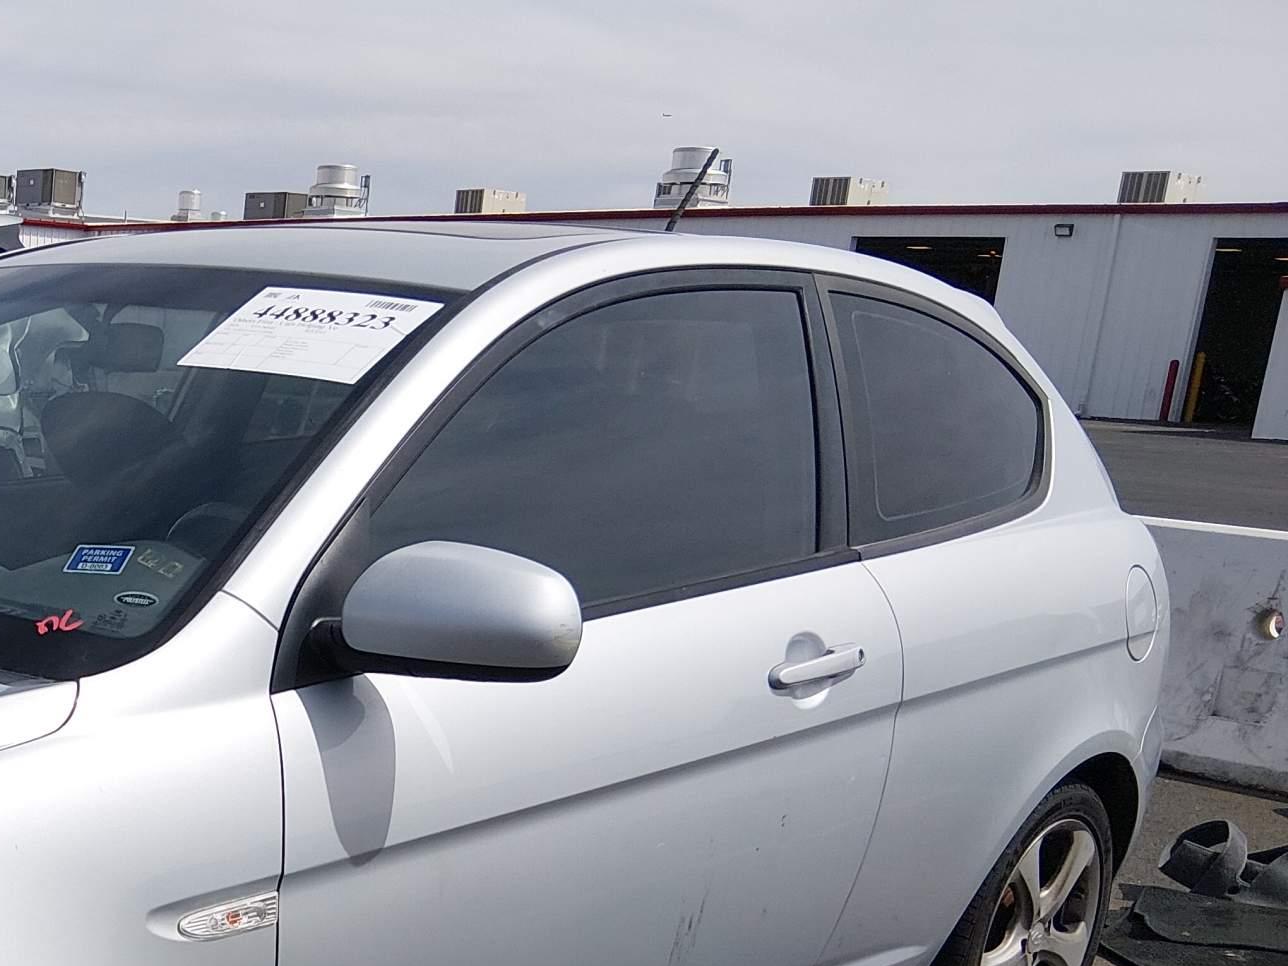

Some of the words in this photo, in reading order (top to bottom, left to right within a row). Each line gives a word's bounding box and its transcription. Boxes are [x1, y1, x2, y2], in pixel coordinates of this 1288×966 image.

[252, 304, 396, 331] 44888323
[81, 549, 124, 557] PARKING
[81, 555, 118, 563] PERMIT
